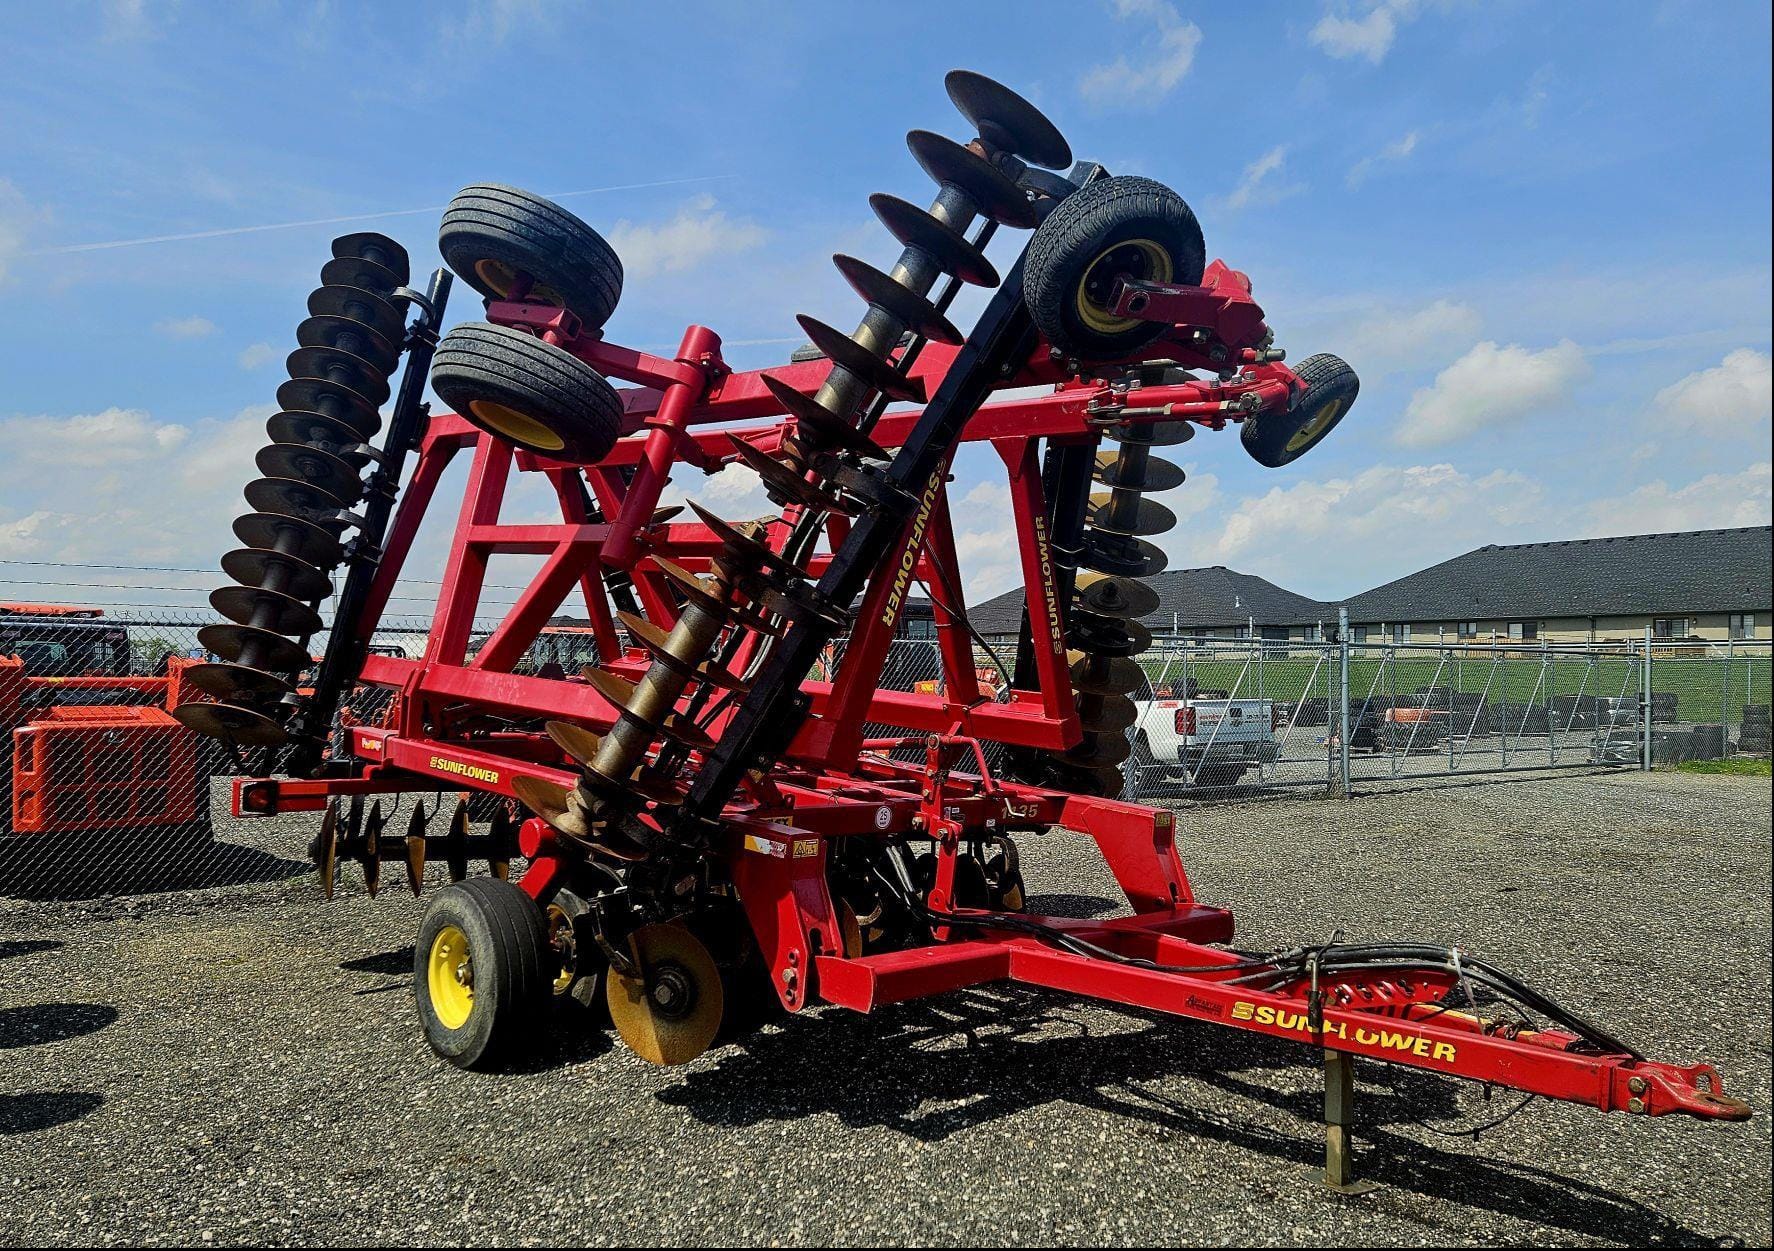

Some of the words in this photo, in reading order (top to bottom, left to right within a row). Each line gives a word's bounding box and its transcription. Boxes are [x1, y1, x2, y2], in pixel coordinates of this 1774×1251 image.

[883, 471, 940, 627] SUNFLOWER
[1035, 516, 1060, 639] SUNFLOWER
[437, 758, 499, 783] SUNFLOWER
